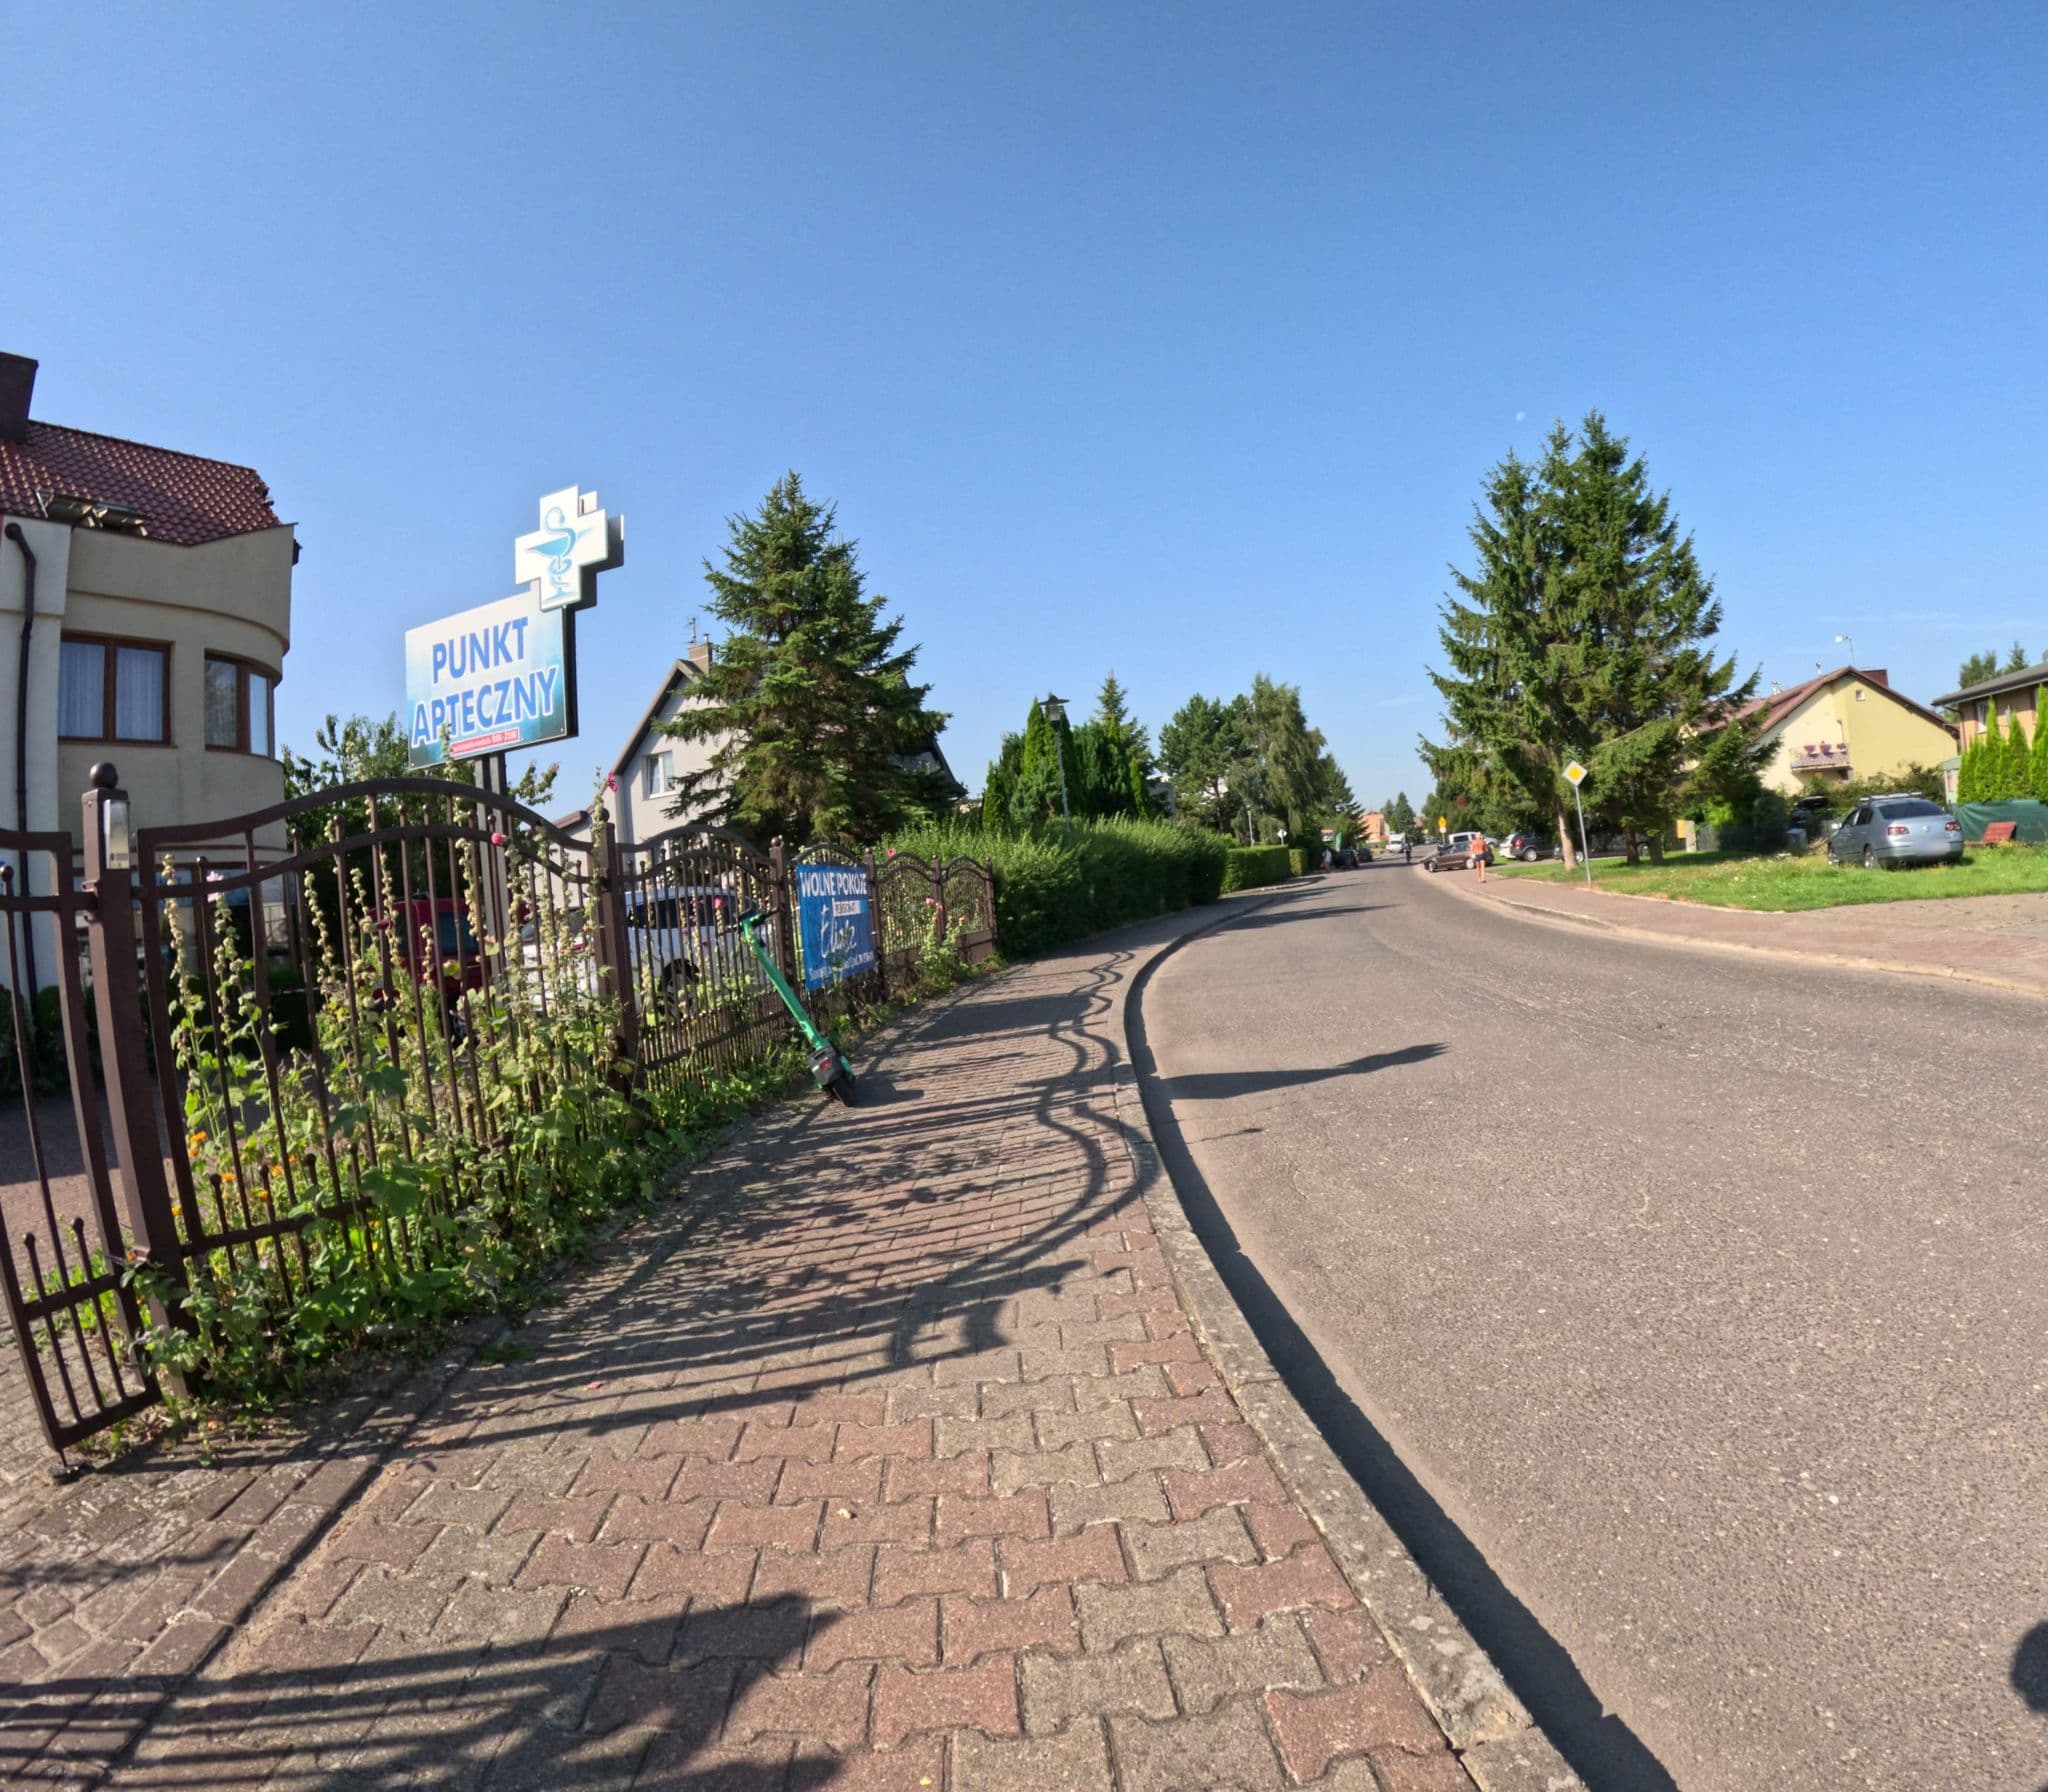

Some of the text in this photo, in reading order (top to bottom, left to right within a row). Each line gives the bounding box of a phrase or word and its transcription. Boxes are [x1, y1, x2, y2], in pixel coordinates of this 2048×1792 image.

[432, 616, 529, 685] PUNKT
[412, 667, 558, 747] APTECZNY
[800, 872, 868, 898] WOLNE POKOJE
